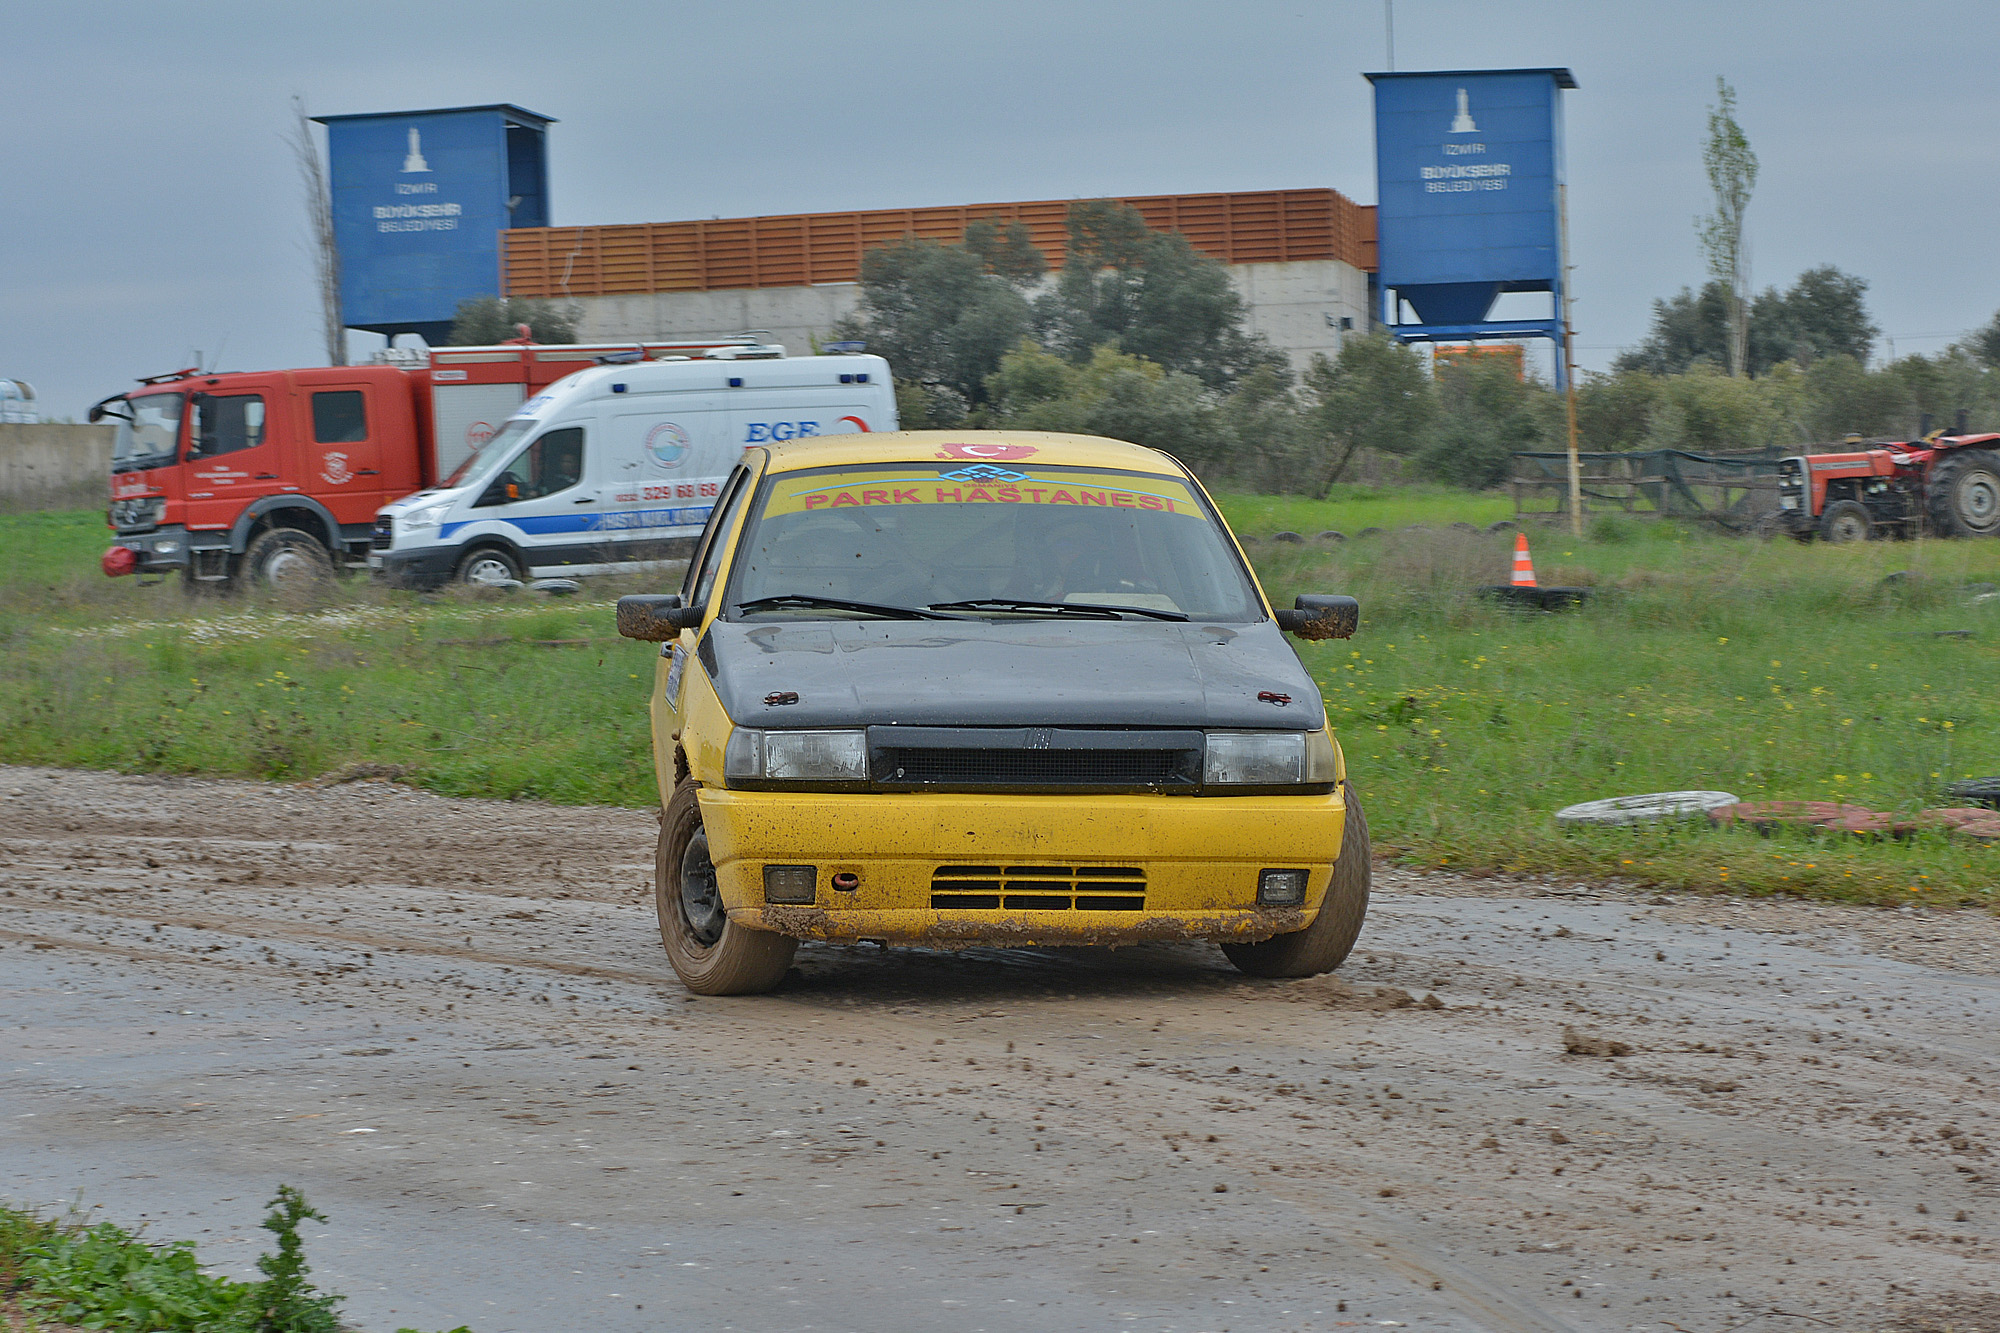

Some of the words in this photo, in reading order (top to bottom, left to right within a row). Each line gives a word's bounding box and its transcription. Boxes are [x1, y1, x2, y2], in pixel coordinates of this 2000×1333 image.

[744, 421, 819, 442] EGE
[641, 485, 672, 501] 329
[676, 484, 695, 499] 68
[699, 482, 719, 497] 68
[804, 488, 922, 510] PARK
